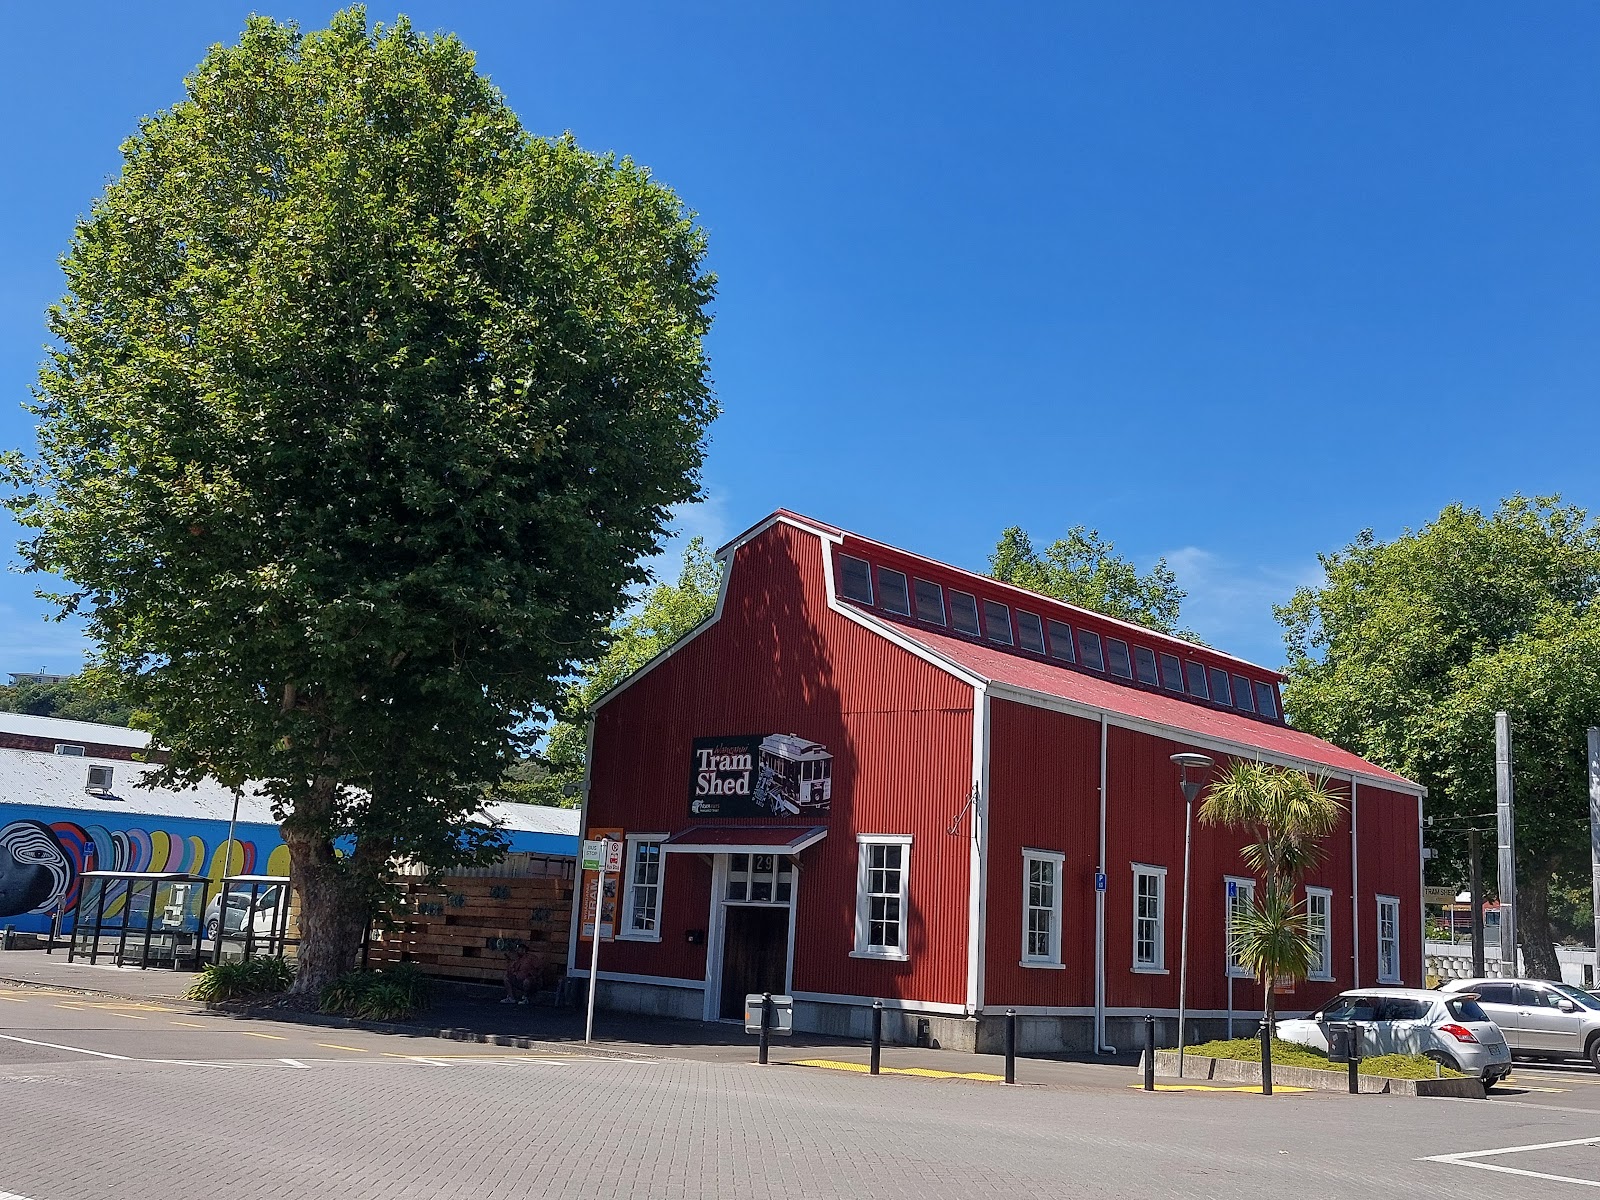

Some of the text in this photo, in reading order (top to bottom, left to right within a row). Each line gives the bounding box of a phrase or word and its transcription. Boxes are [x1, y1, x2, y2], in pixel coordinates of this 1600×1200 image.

[697, 749, 752, 771] Tram
[696, 771, 750, 795] Shed
[756, 855, 772, 870] 29
[587, 878, 599, 920] TRAM
